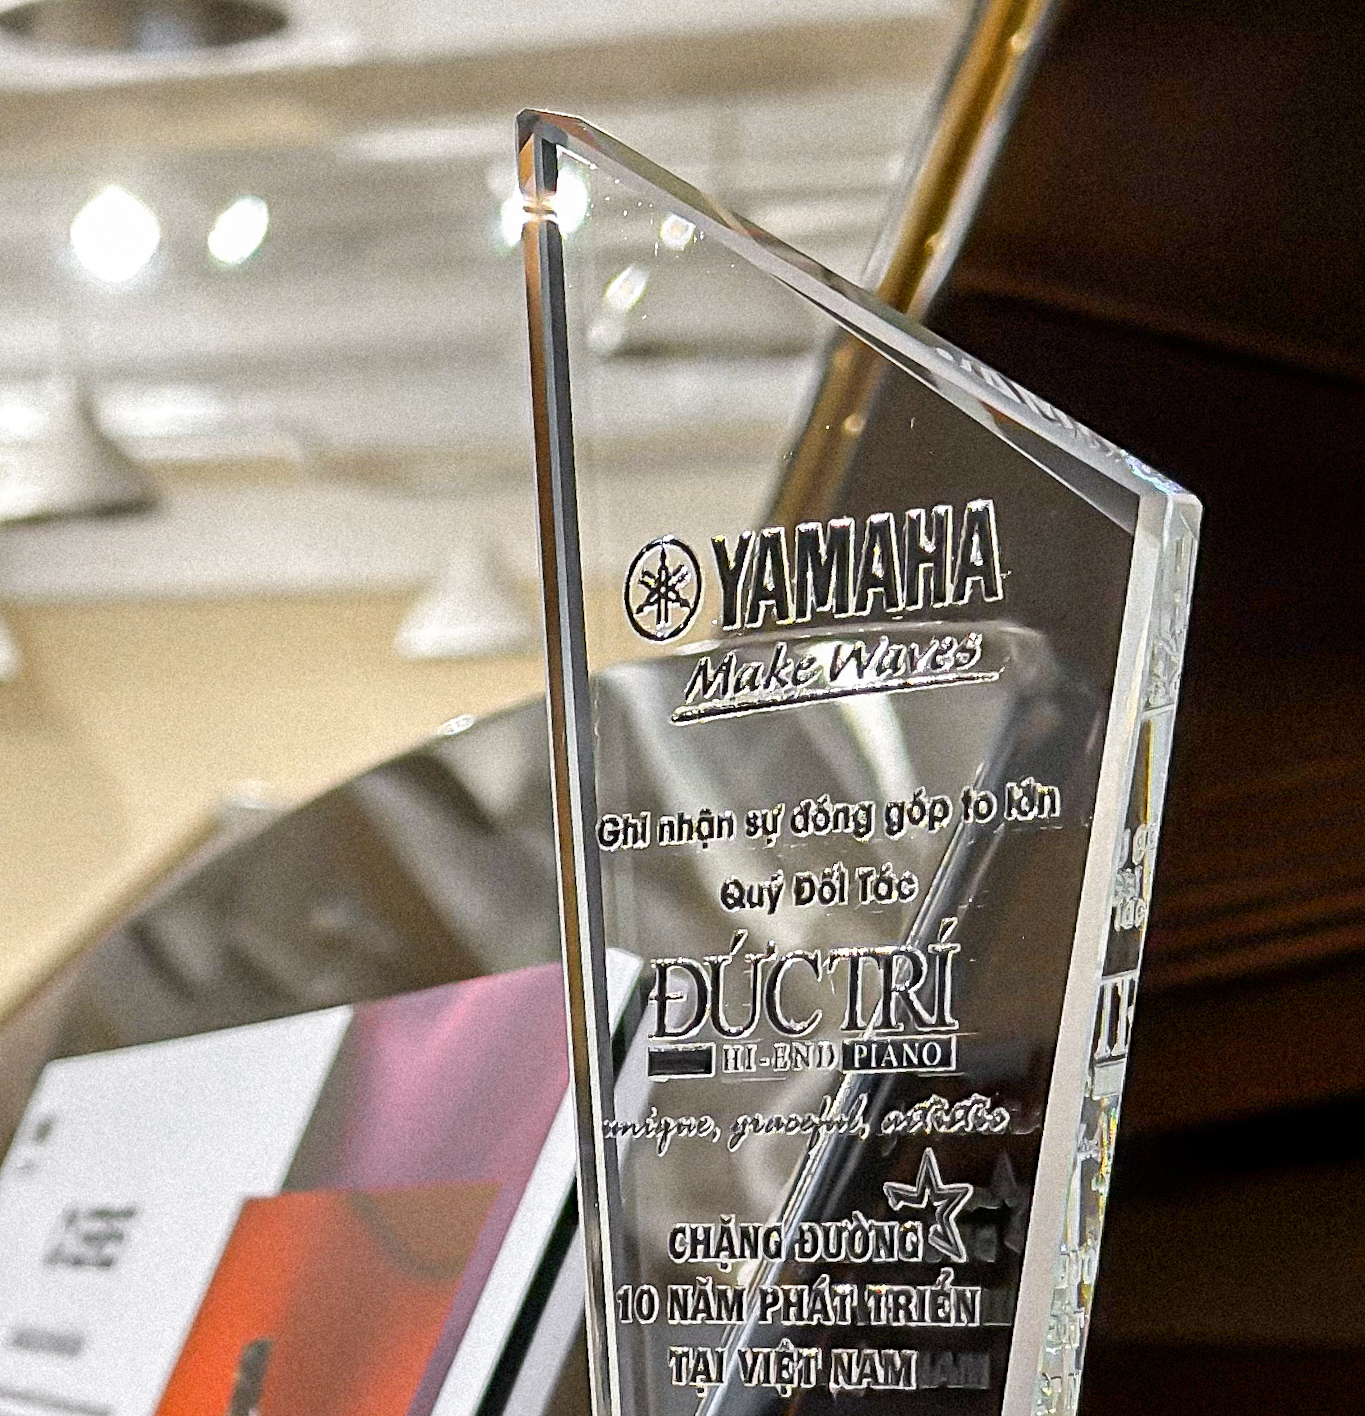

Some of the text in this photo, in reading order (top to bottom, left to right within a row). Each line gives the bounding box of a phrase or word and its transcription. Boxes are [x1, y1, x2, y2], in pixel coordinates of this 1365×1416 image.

[710, 499, 1004, 631] YAMAHA
[684, 631, 983, 706] Make Waves
[596, 811, 651, 851] Ghi
[657, 808, 736, 850] nhận
[745, 803, 786, 848] sự
[790, 793, 876, 841] đóng
[884, 786, 953, 840] góp
[960, 785, 998, 824] to
[720, 868, 785, 916] Quý
[855, 861, 920, 906] Tác
[647, 916, 962, 1041] ĐỨC TRÍ
[852, 1038, 943, 1070] PIANO
[666, 1210, 924, 1272] CHẶNG ĐƯỜNG
[616, 1283, 659, 1325] 10
[666, 1275, 747, 1325] NĂM
[756, 1273, 857, 1326] PHÁT
[667, 1338, 917, 1397] TẠI VIỆT NAM
